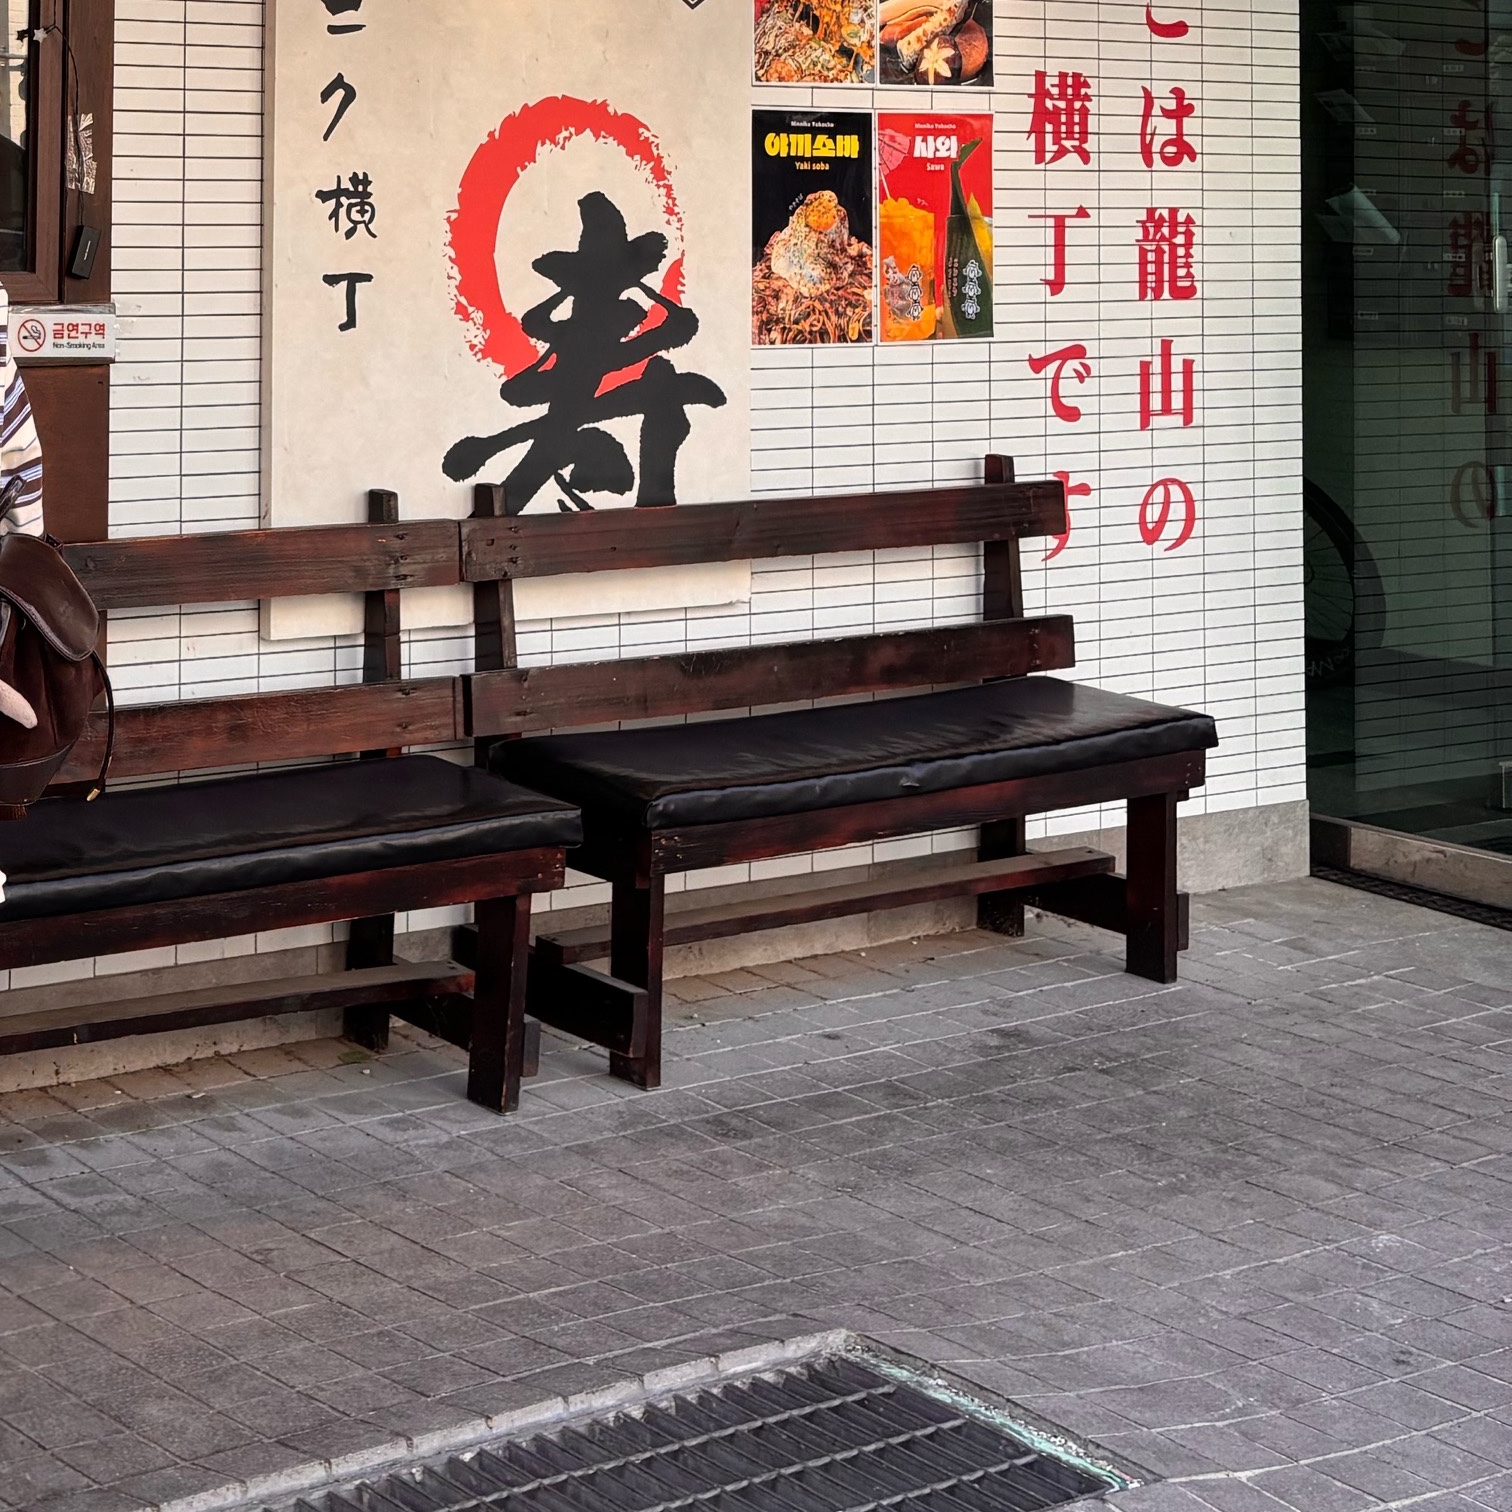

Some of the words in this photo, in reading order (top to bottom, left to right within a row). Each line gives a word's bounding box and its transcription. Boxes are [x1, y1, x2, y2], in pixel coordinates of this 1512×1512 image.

[764, 132, 860, 159] 야끼소바
[913, 135, 958, 159] 사와
[794, 161, 811, 170] Yaki
[812, 161, 830, 171] soba
[52, 322, 106, 340] 금연구역
[52, 341, 91, 350] Non-Smoking
